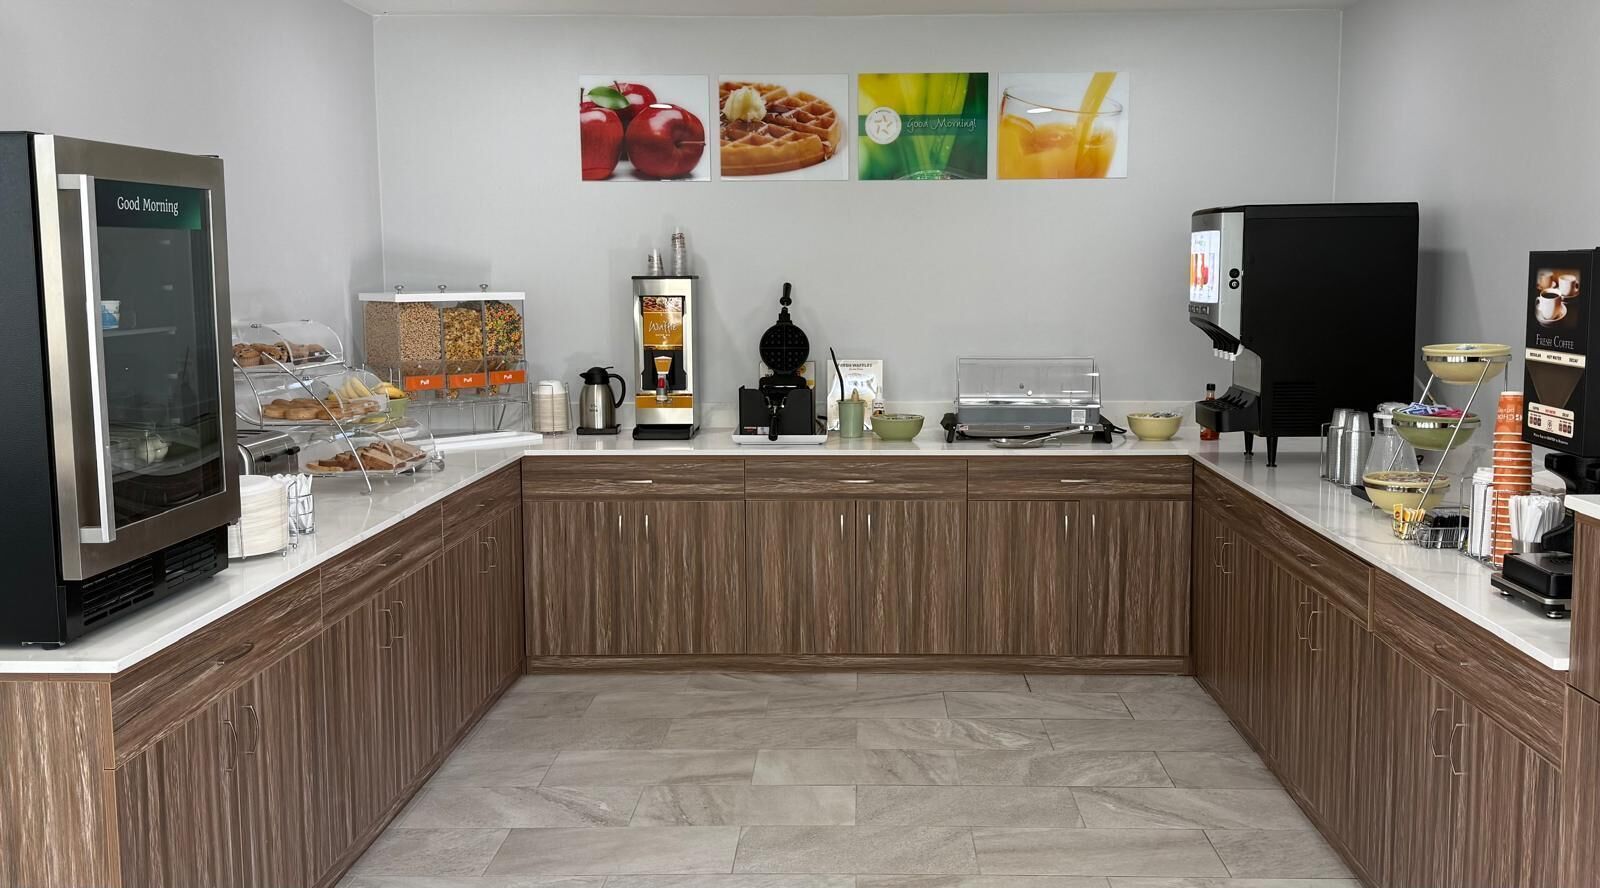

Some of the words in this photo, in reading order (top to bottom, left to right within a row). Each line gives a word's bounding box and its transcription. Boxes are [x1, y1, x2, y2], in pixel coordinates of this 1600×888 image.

[906, 118, 928, 133] Good
[930, 117, 977, 132] Morning!
[117, 196, 140, 210] Good
[142, 198, 179, 216] Morning
